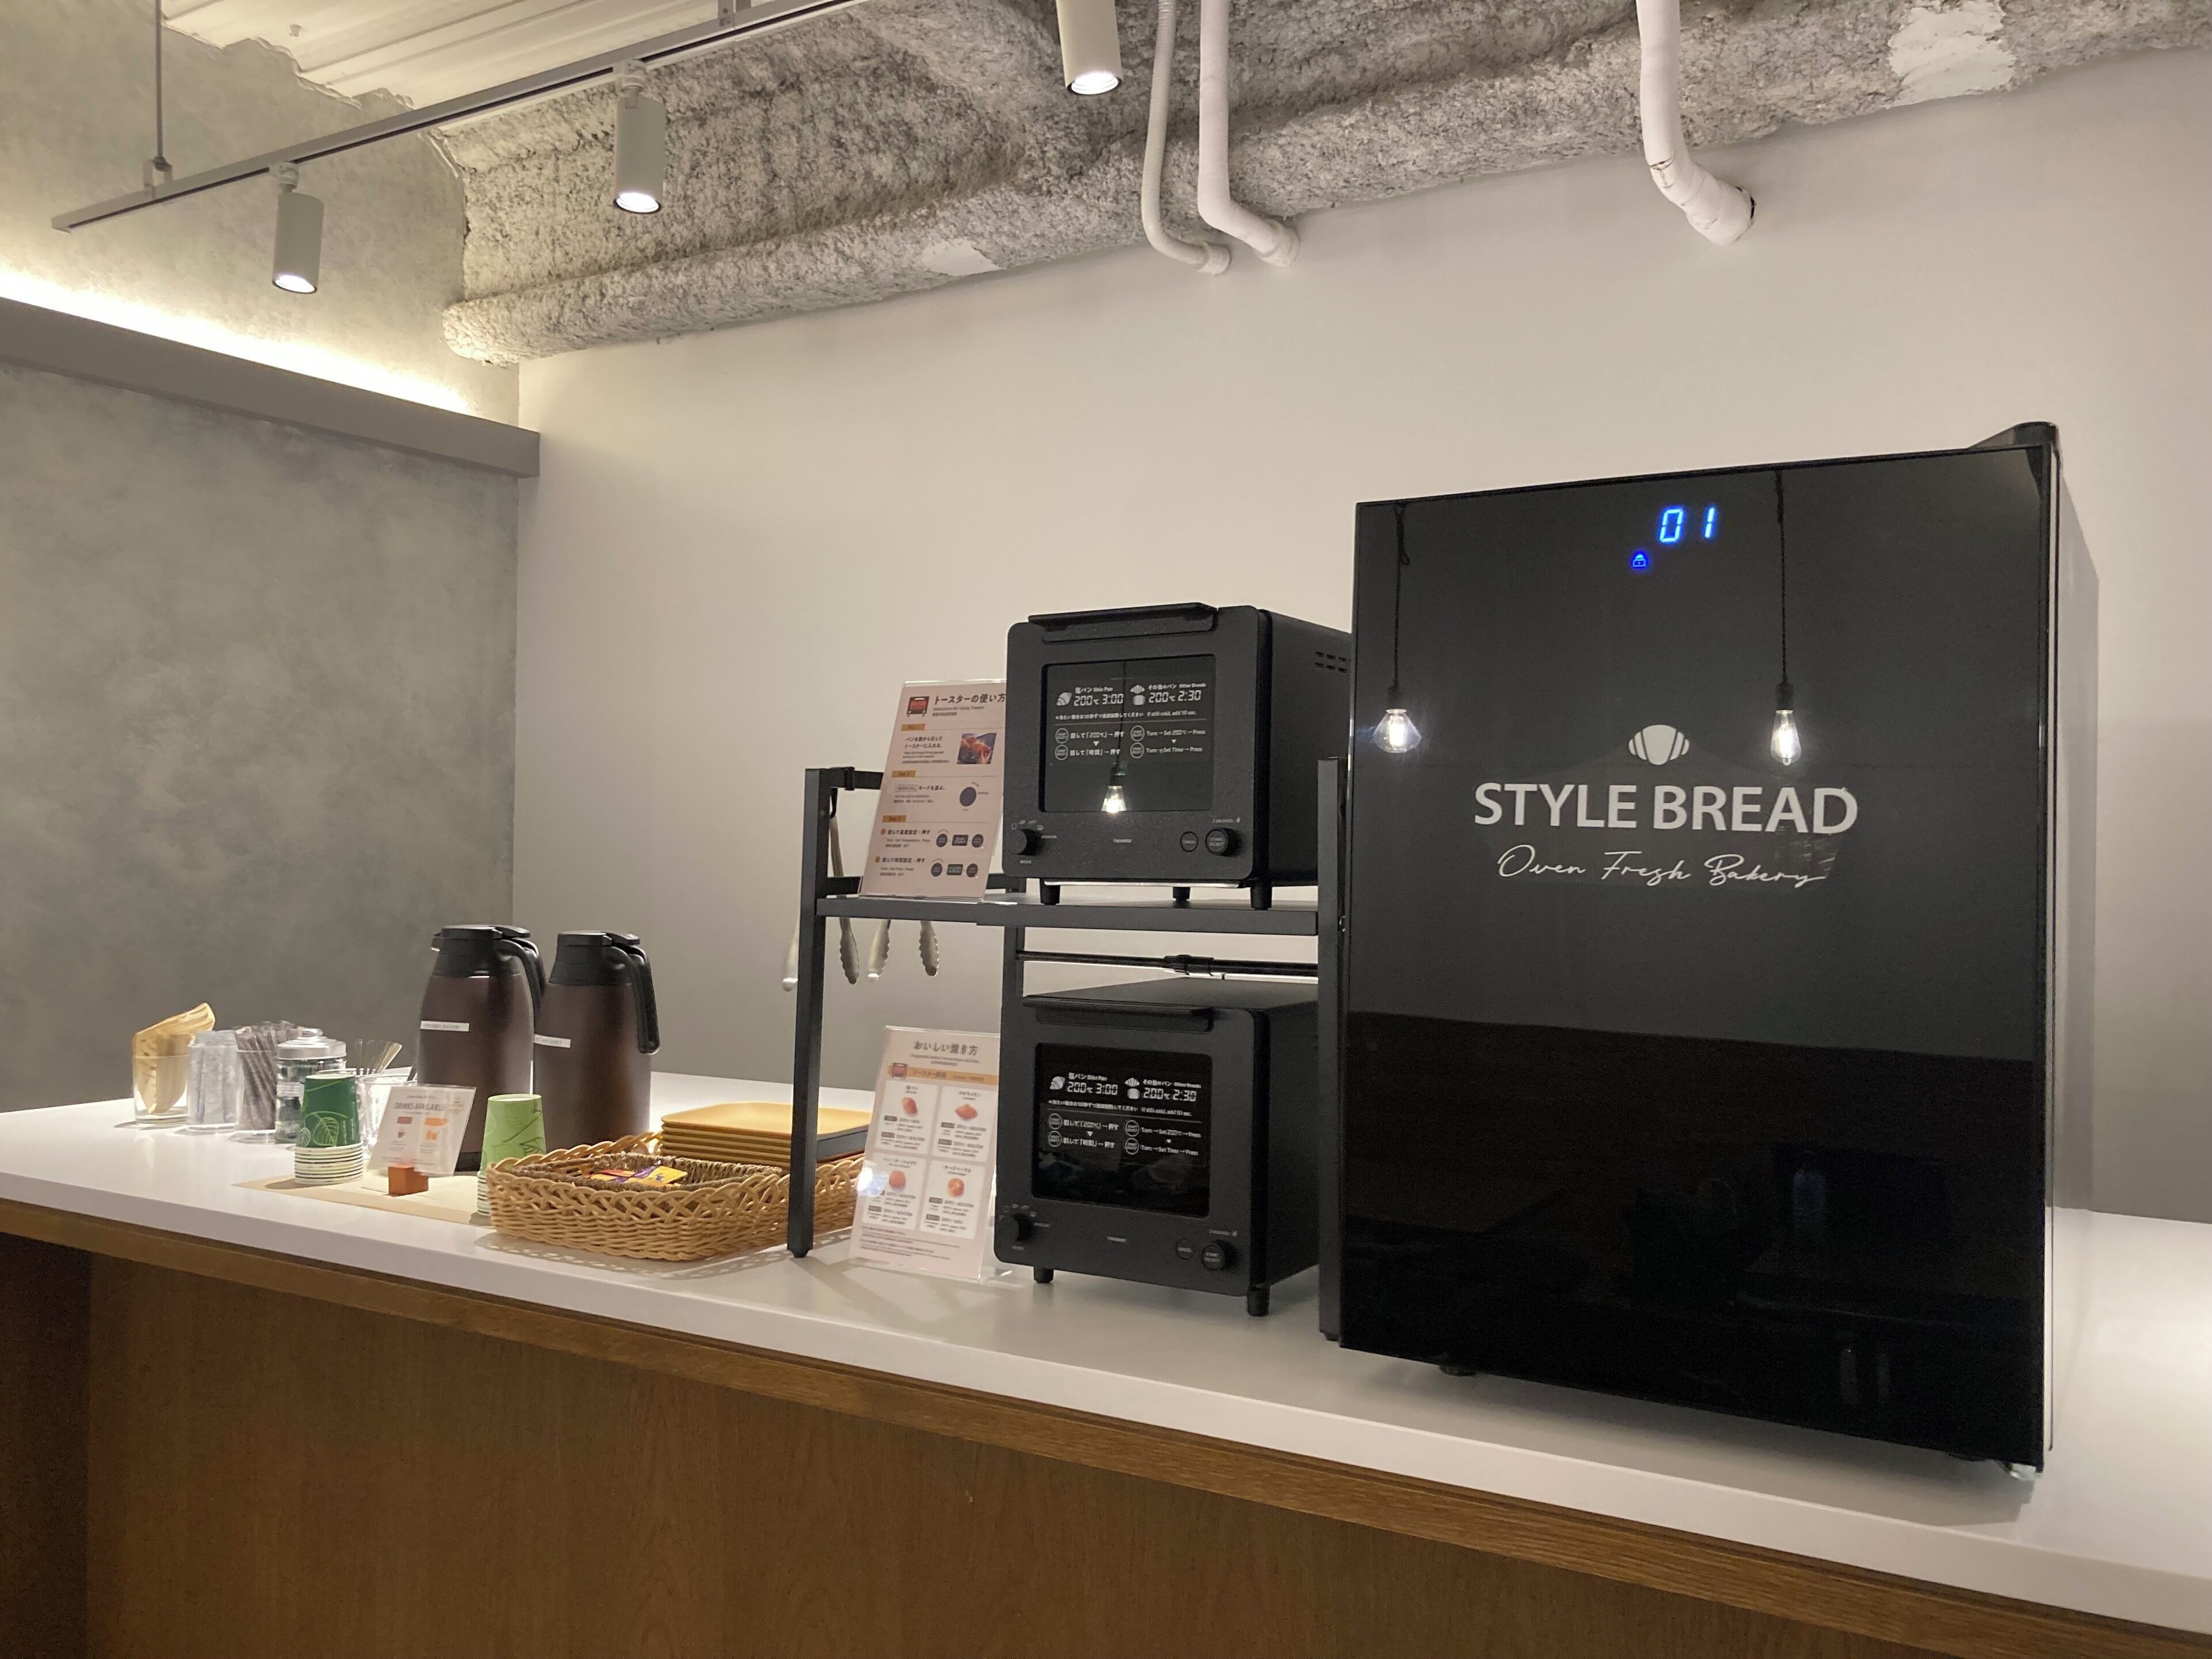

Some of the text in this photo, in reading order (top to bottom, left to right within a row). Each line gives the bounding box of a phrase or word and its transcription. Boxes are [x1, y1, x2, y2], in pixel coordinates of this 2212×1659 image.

[1659, 507, 1715, 542] 01
[934, 693, 1006, 705] トースターの使い方
[1101, 693, 1124, 704] 3:00
[1177, 690, 1202, 702] 2:30
[1474, 782, 1858, 834] STYLE BREAD
[1497, 844, 1826, 888] Oven Fresh Bakery
[914, 1040, 979, 1056] おいしい焼き方
[1096, 1083, 1118, 1095] 3:00
[1173, 1089, 1197, 1101] 2:30
